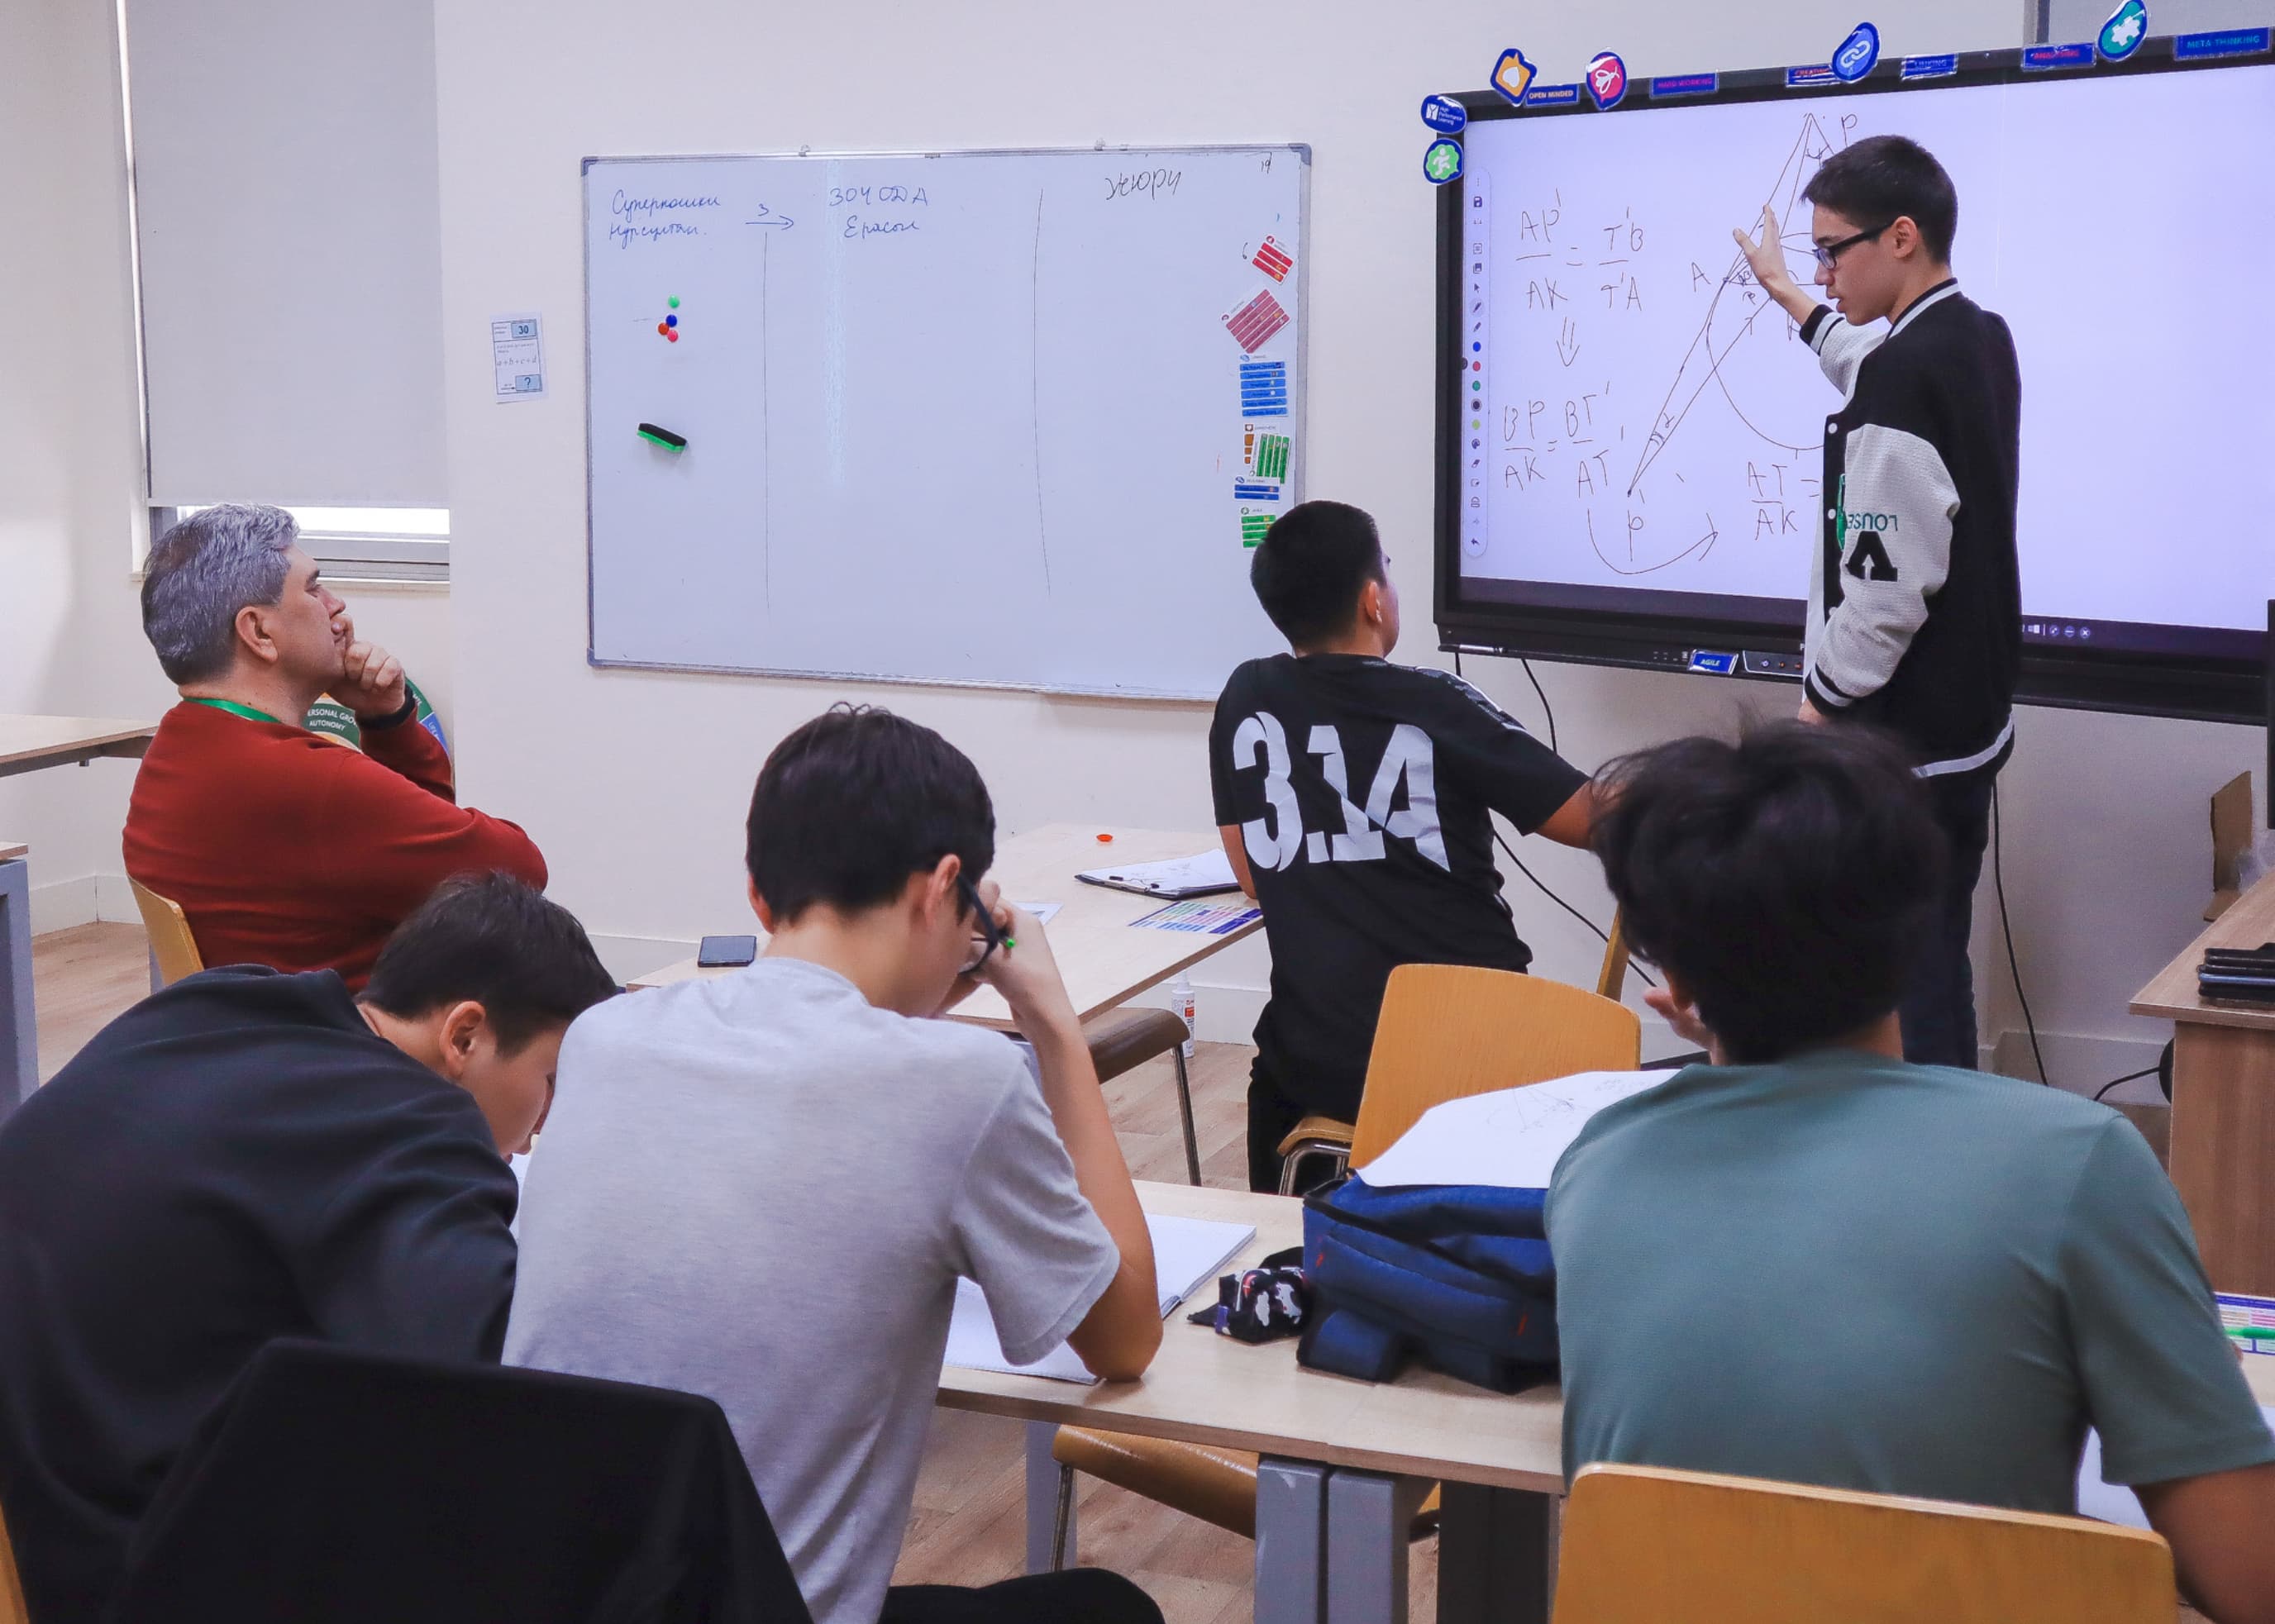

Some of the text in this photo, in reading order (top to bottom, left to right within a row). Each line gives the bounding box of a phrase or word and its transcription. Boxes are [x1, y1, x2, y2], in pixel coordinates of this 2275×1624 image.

[2187, 35, 2261, 48] META THINKING
[1657, 78, 1713, 89] HARD WORKING
[1528, 89, 1575, 100] OPEN MINDED
[1691, 261, 1712, 293] A
[1526, 277, 1568, 311] AK
[517, 325, 529, 335] 30
[523, 377, 532, 388] ?
[1503, 399, 1545, 443] BP
[1505, 455, 1547, 492] AK
[1747, 460, 1789, 498] AT
[1754, 505, 1799, 541] AK
[1700, 659, 1721, 667] AGILE
[307, 707, 339, 718] ERSONAL
[308, 719, 346, 731] AUTONOMY
[1233, 711, 1451, 874] 3.14
